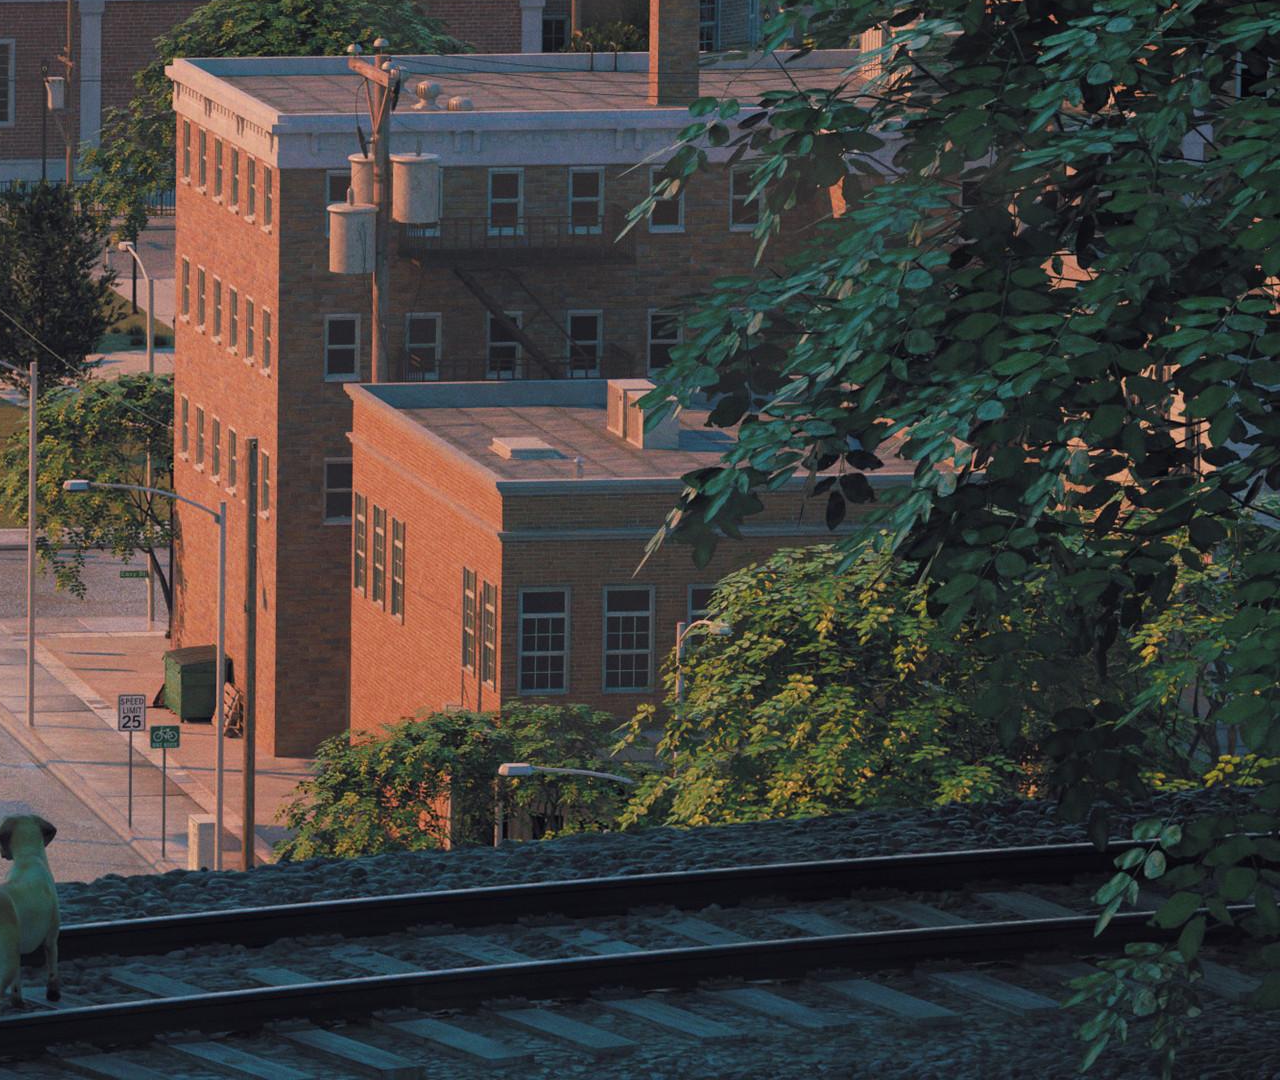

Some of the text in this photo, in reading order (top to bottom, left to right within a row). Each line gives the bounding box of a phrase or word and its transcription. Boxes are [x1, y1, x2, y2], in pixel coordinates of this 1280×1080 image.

[120, 697, 144, 706] SPEED
[122, 706, 142, 715] LIMIT
[122, 715, 142, 729] 25
